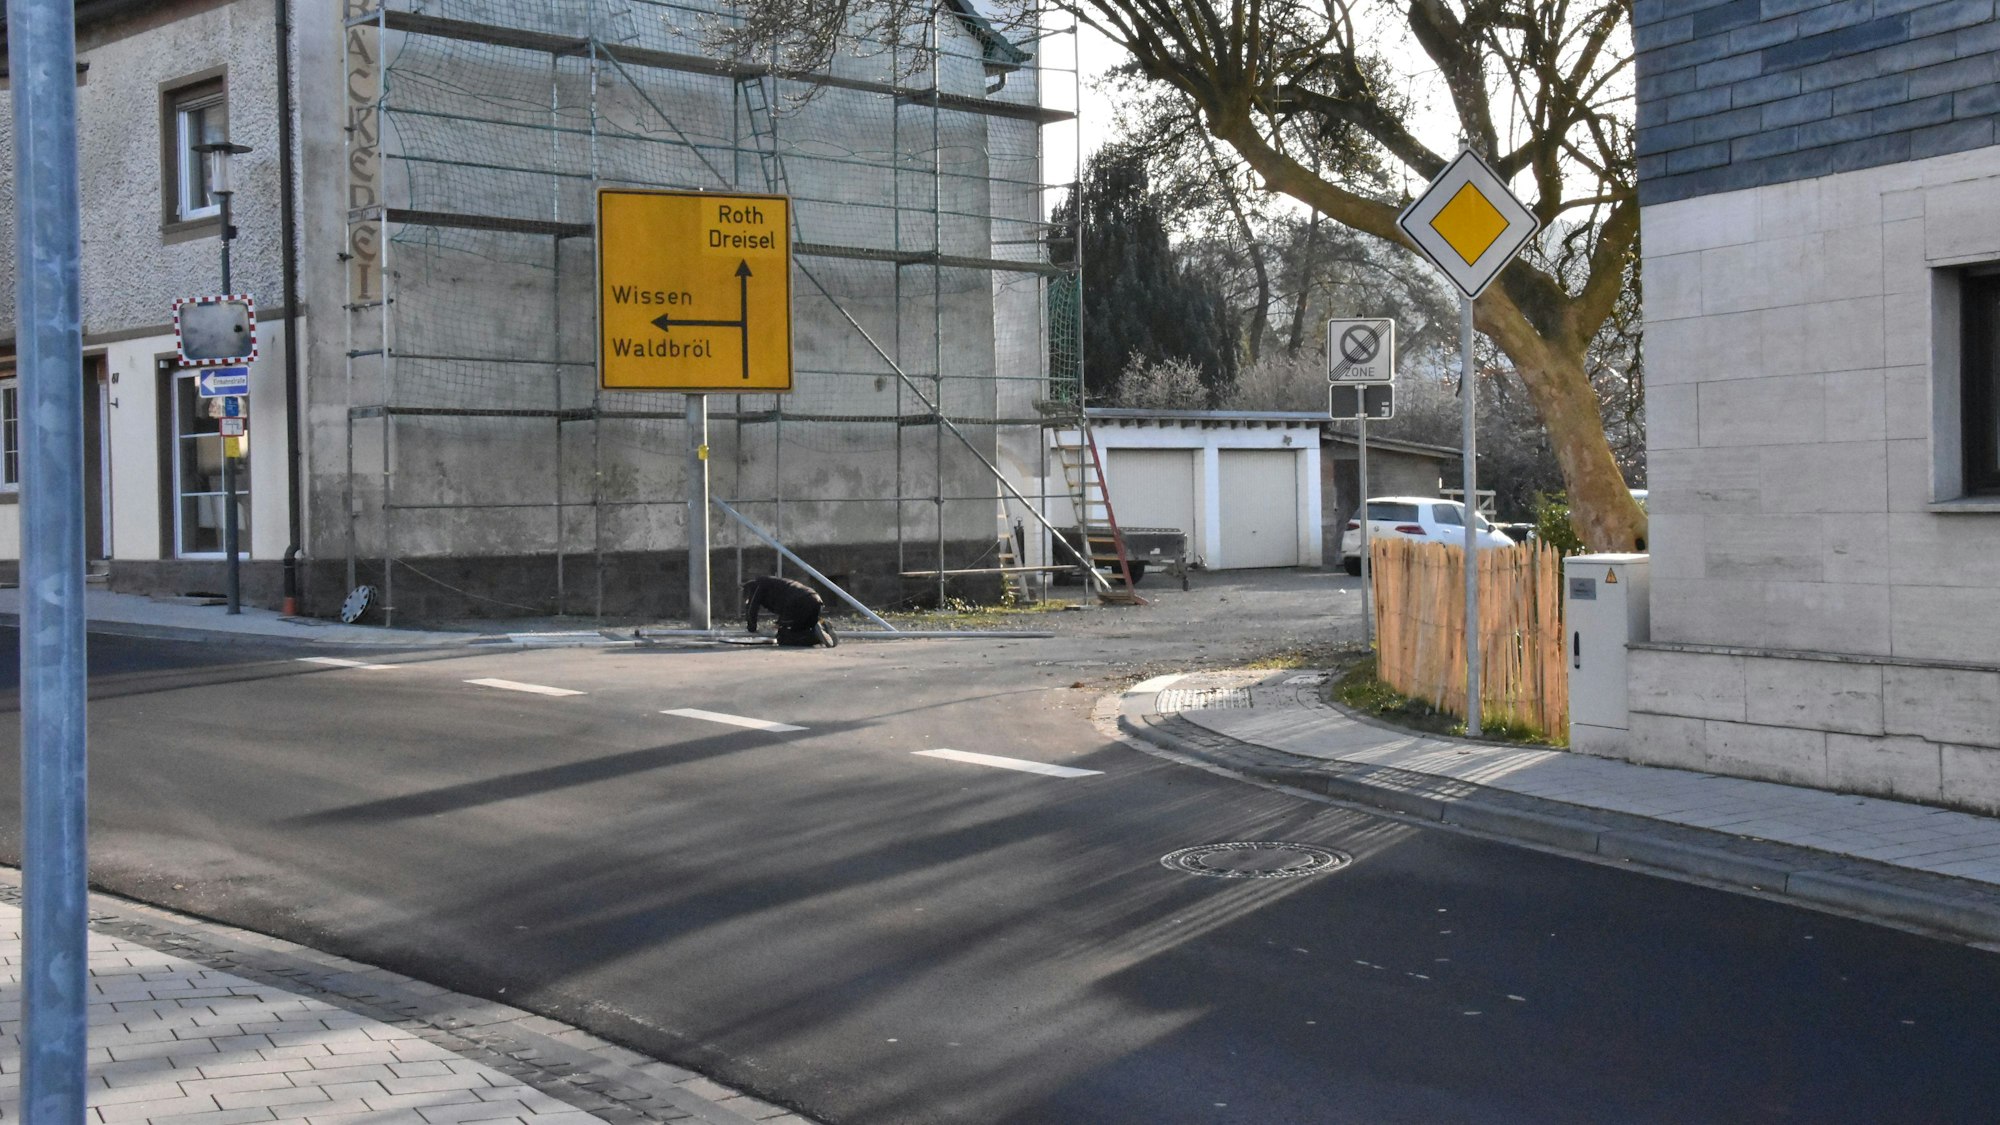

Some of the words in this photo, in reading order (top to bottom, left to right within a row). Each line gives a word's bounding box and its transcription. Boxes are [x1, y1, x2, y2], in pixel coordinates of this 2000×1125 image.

[718, 205, 763, 224] Roth
[709, 230, 775, 249] Dreisel
[611, 285, 692, 305] Wissen
[612, 338, 712, 358] Waldbröl
[1345, 367, 1375, 377] ZONE
